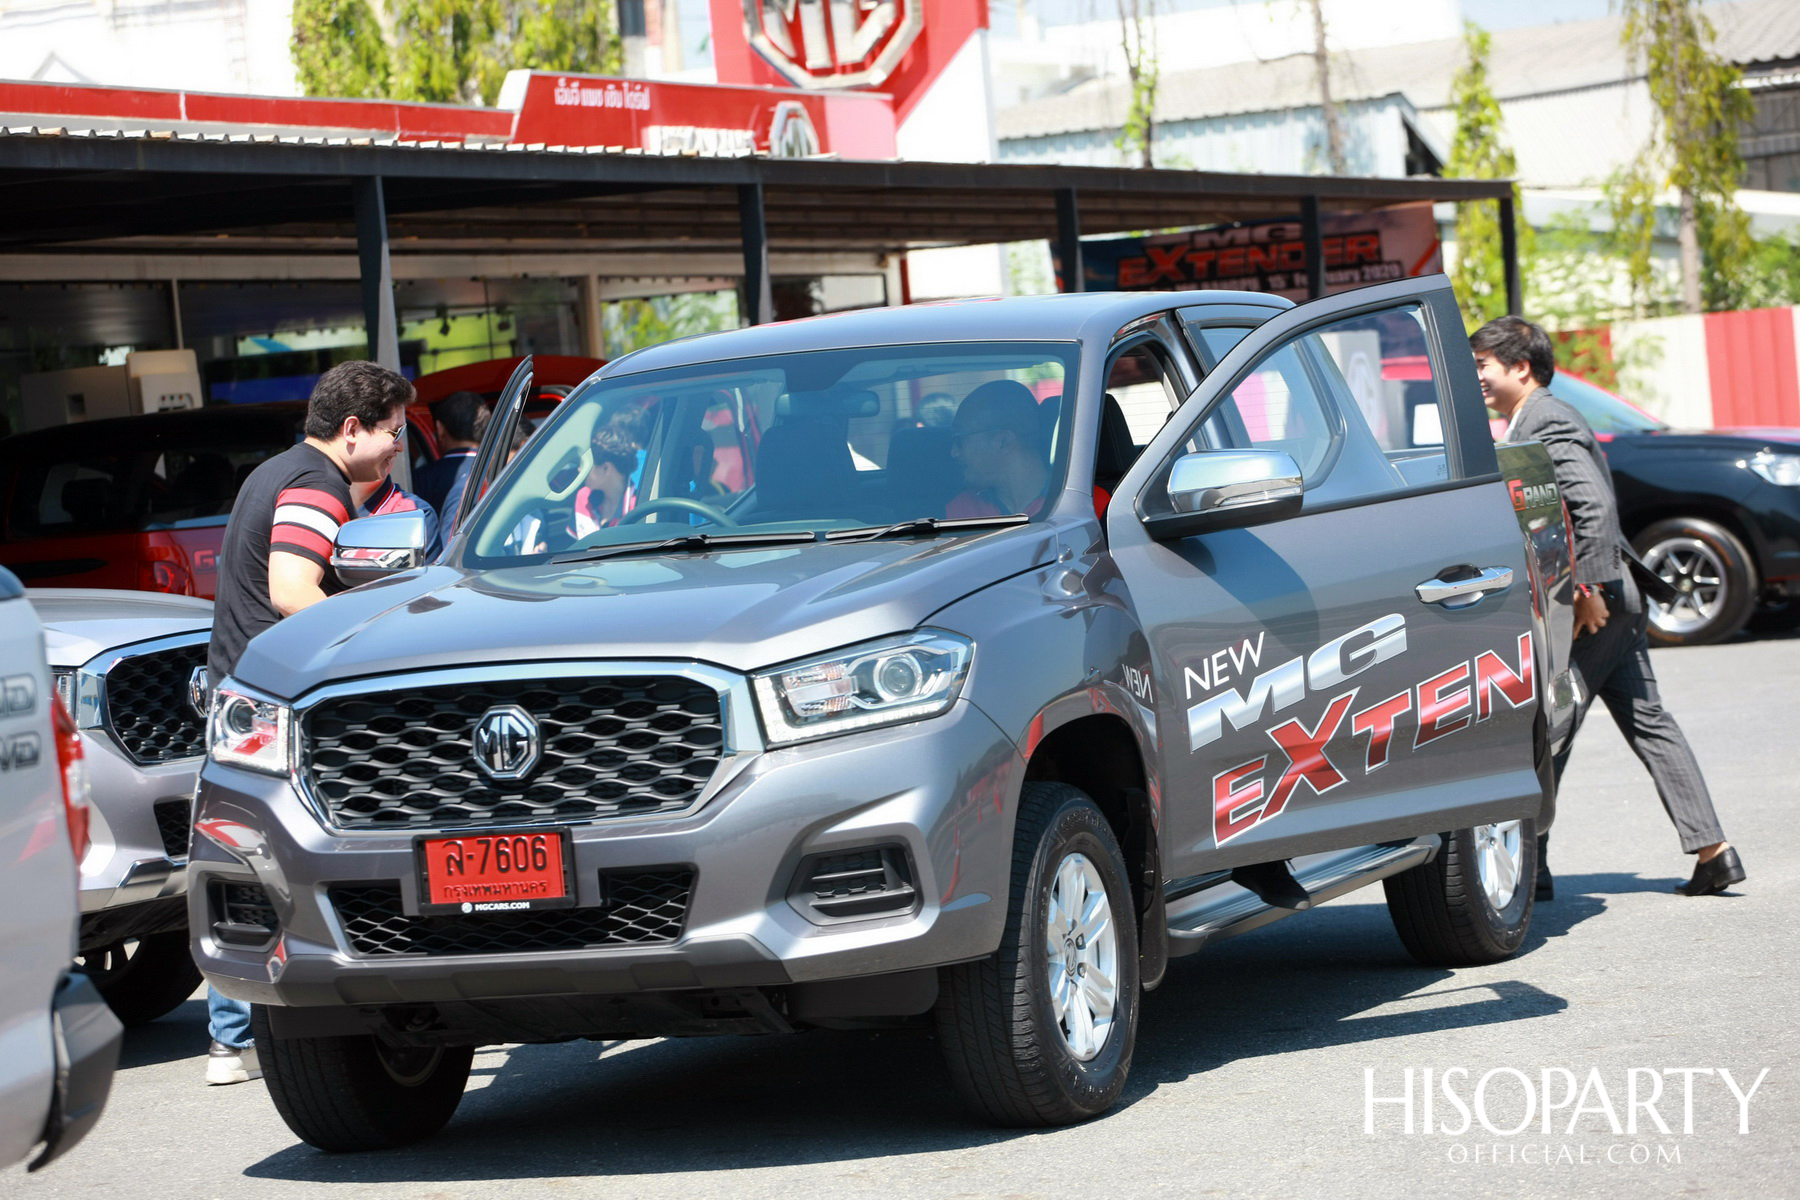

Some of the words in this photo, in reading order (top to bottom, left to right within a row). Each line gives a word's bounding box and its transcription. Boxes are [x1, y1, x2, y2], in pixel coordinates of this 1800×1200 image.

[1508, 479, 1558, 512] GRAND
[1184, 631, 1265, 700] NEW
[1187, 613, 1408, 754] MG
[479, 715, 528, 770] MG
[1212, 630, 1537, 849] EXTEN
[474, 902, 531, 912] MGCARS.COM
